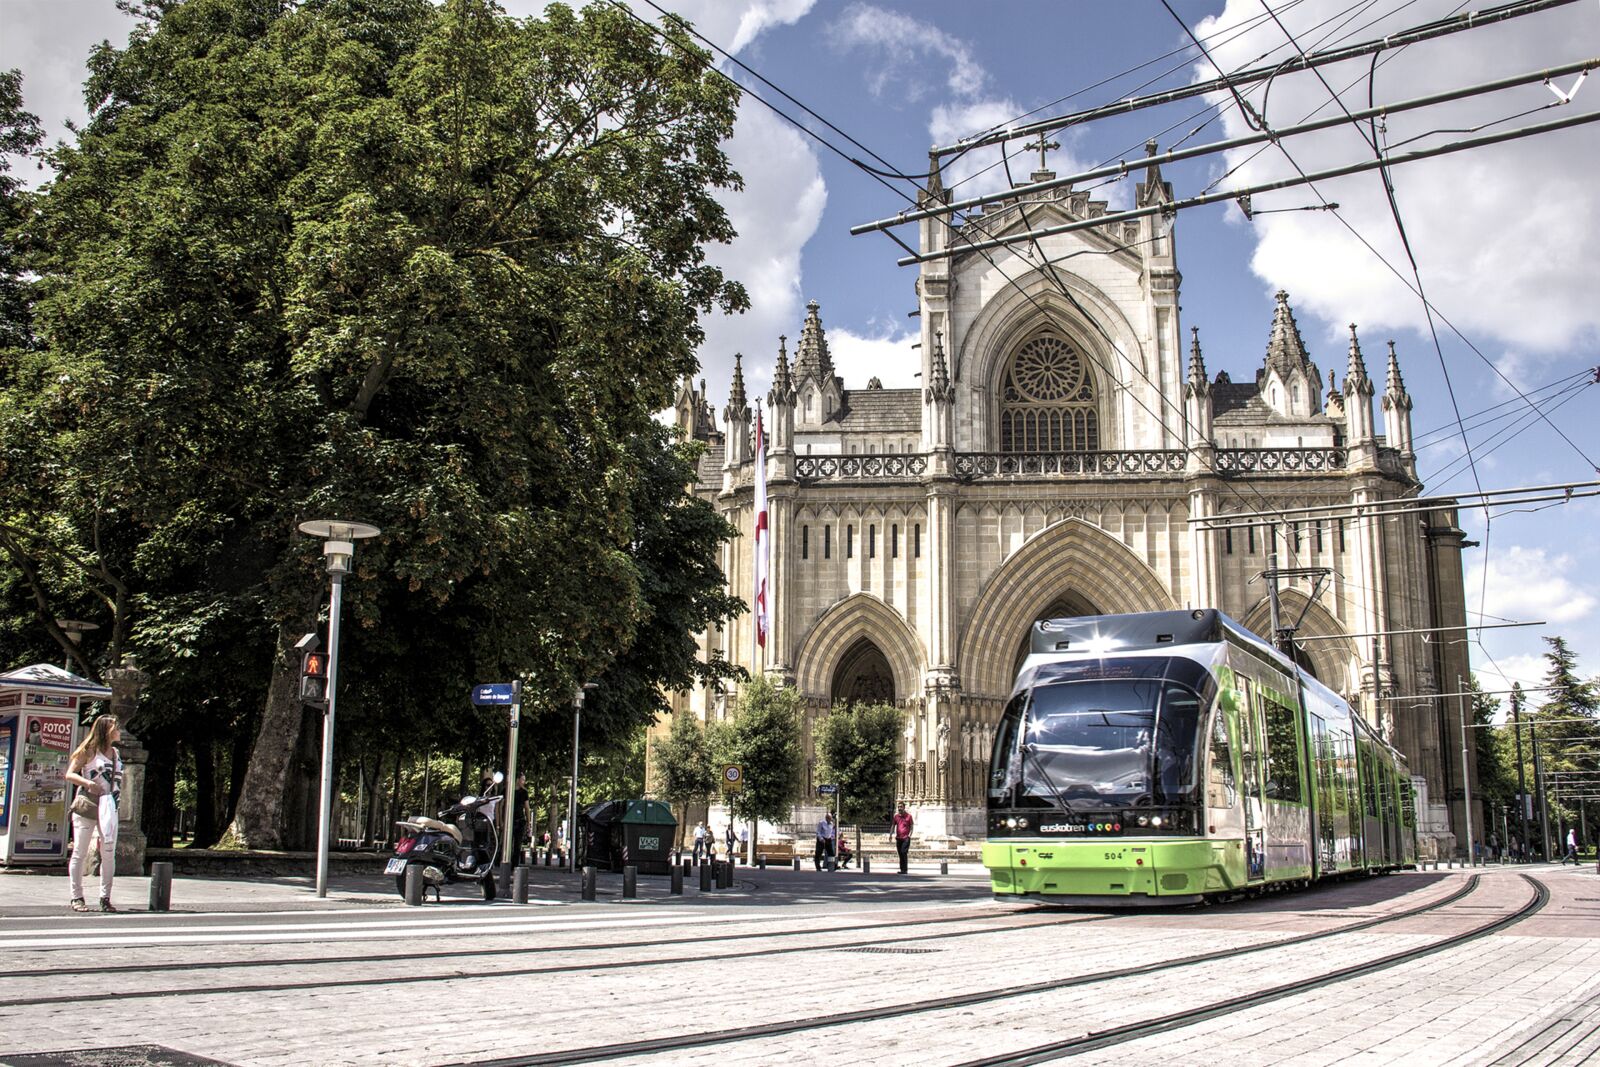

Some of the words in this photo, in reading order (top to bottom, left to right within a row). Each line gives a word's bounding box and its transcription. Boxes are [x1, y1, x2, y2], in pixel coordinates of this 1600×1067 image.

[43, 722, 71, 734] FOTOS
[42, 738, 70, 749] DOCUMENTOS
[728, 770, 738, 778] 30
[1040, 824, 1085, 832] euskotren
